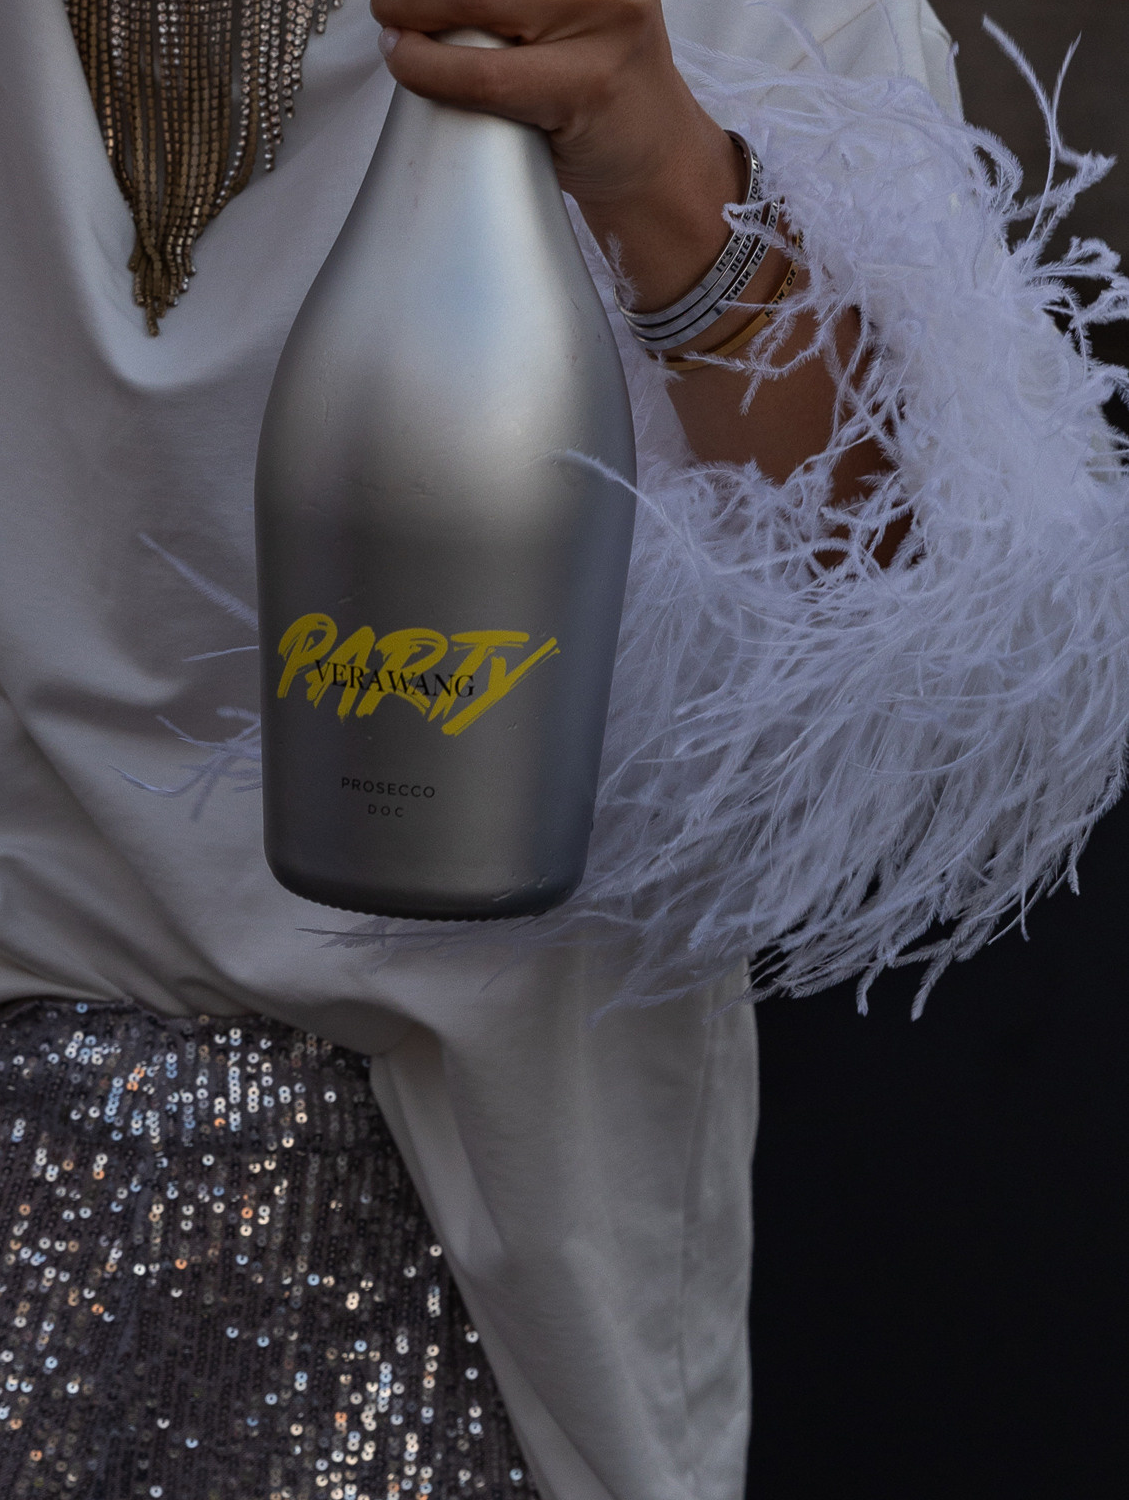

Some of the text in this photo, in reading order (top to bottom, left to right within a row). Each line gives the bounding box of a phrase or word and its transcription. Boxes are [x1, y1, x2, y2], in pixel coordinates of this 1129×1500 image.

[716, 249, 733, 273] IT'S
[750, 178, 759, 200] TOO
[786, 269, 797, 286] OR
[277, 612, 561, 737] PARTY
[341, 777, 436, 799] PROSECCO
